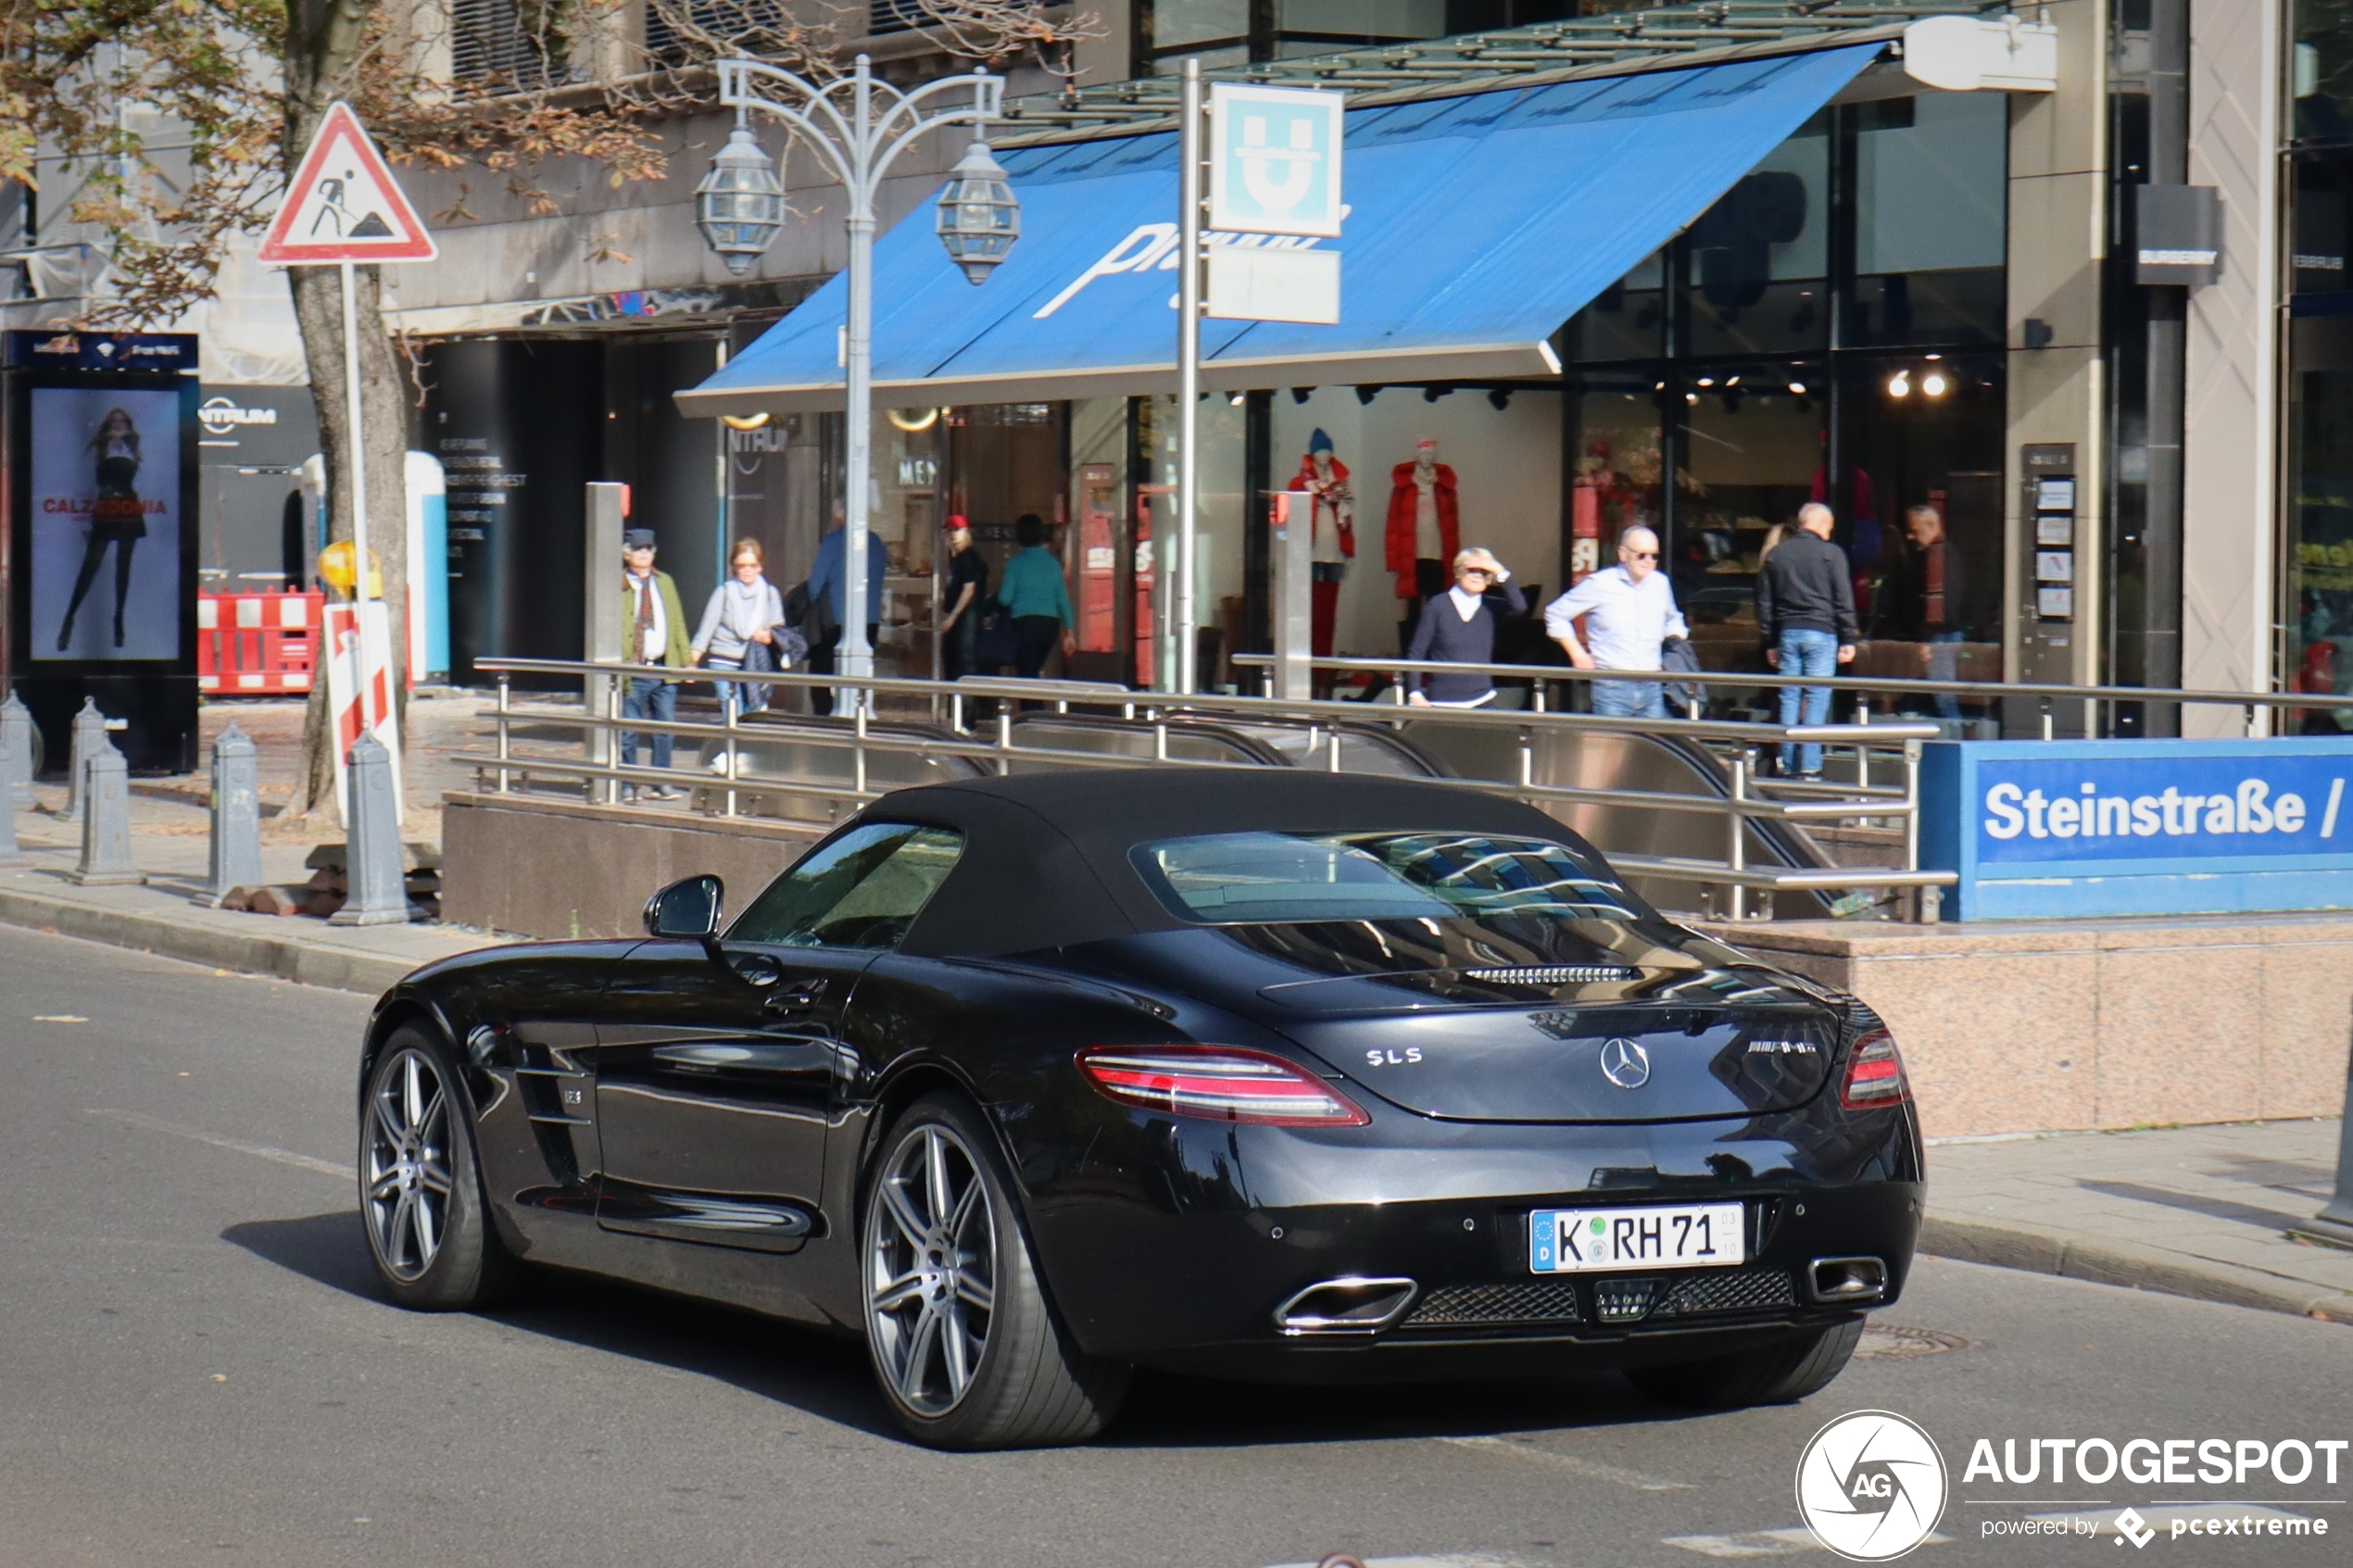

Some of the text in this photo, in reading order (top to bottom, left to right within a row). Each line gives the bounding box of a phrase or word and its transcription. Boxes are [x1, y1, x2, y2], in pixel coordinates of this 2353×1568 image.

[1984, 778, 2307, 840] Steinstraße
[1366, 1047, 1423, 1067] SLS
[1540, 1247, 1550, 1261] D
[1559, 1213, 1717, 1262] K RH 71
